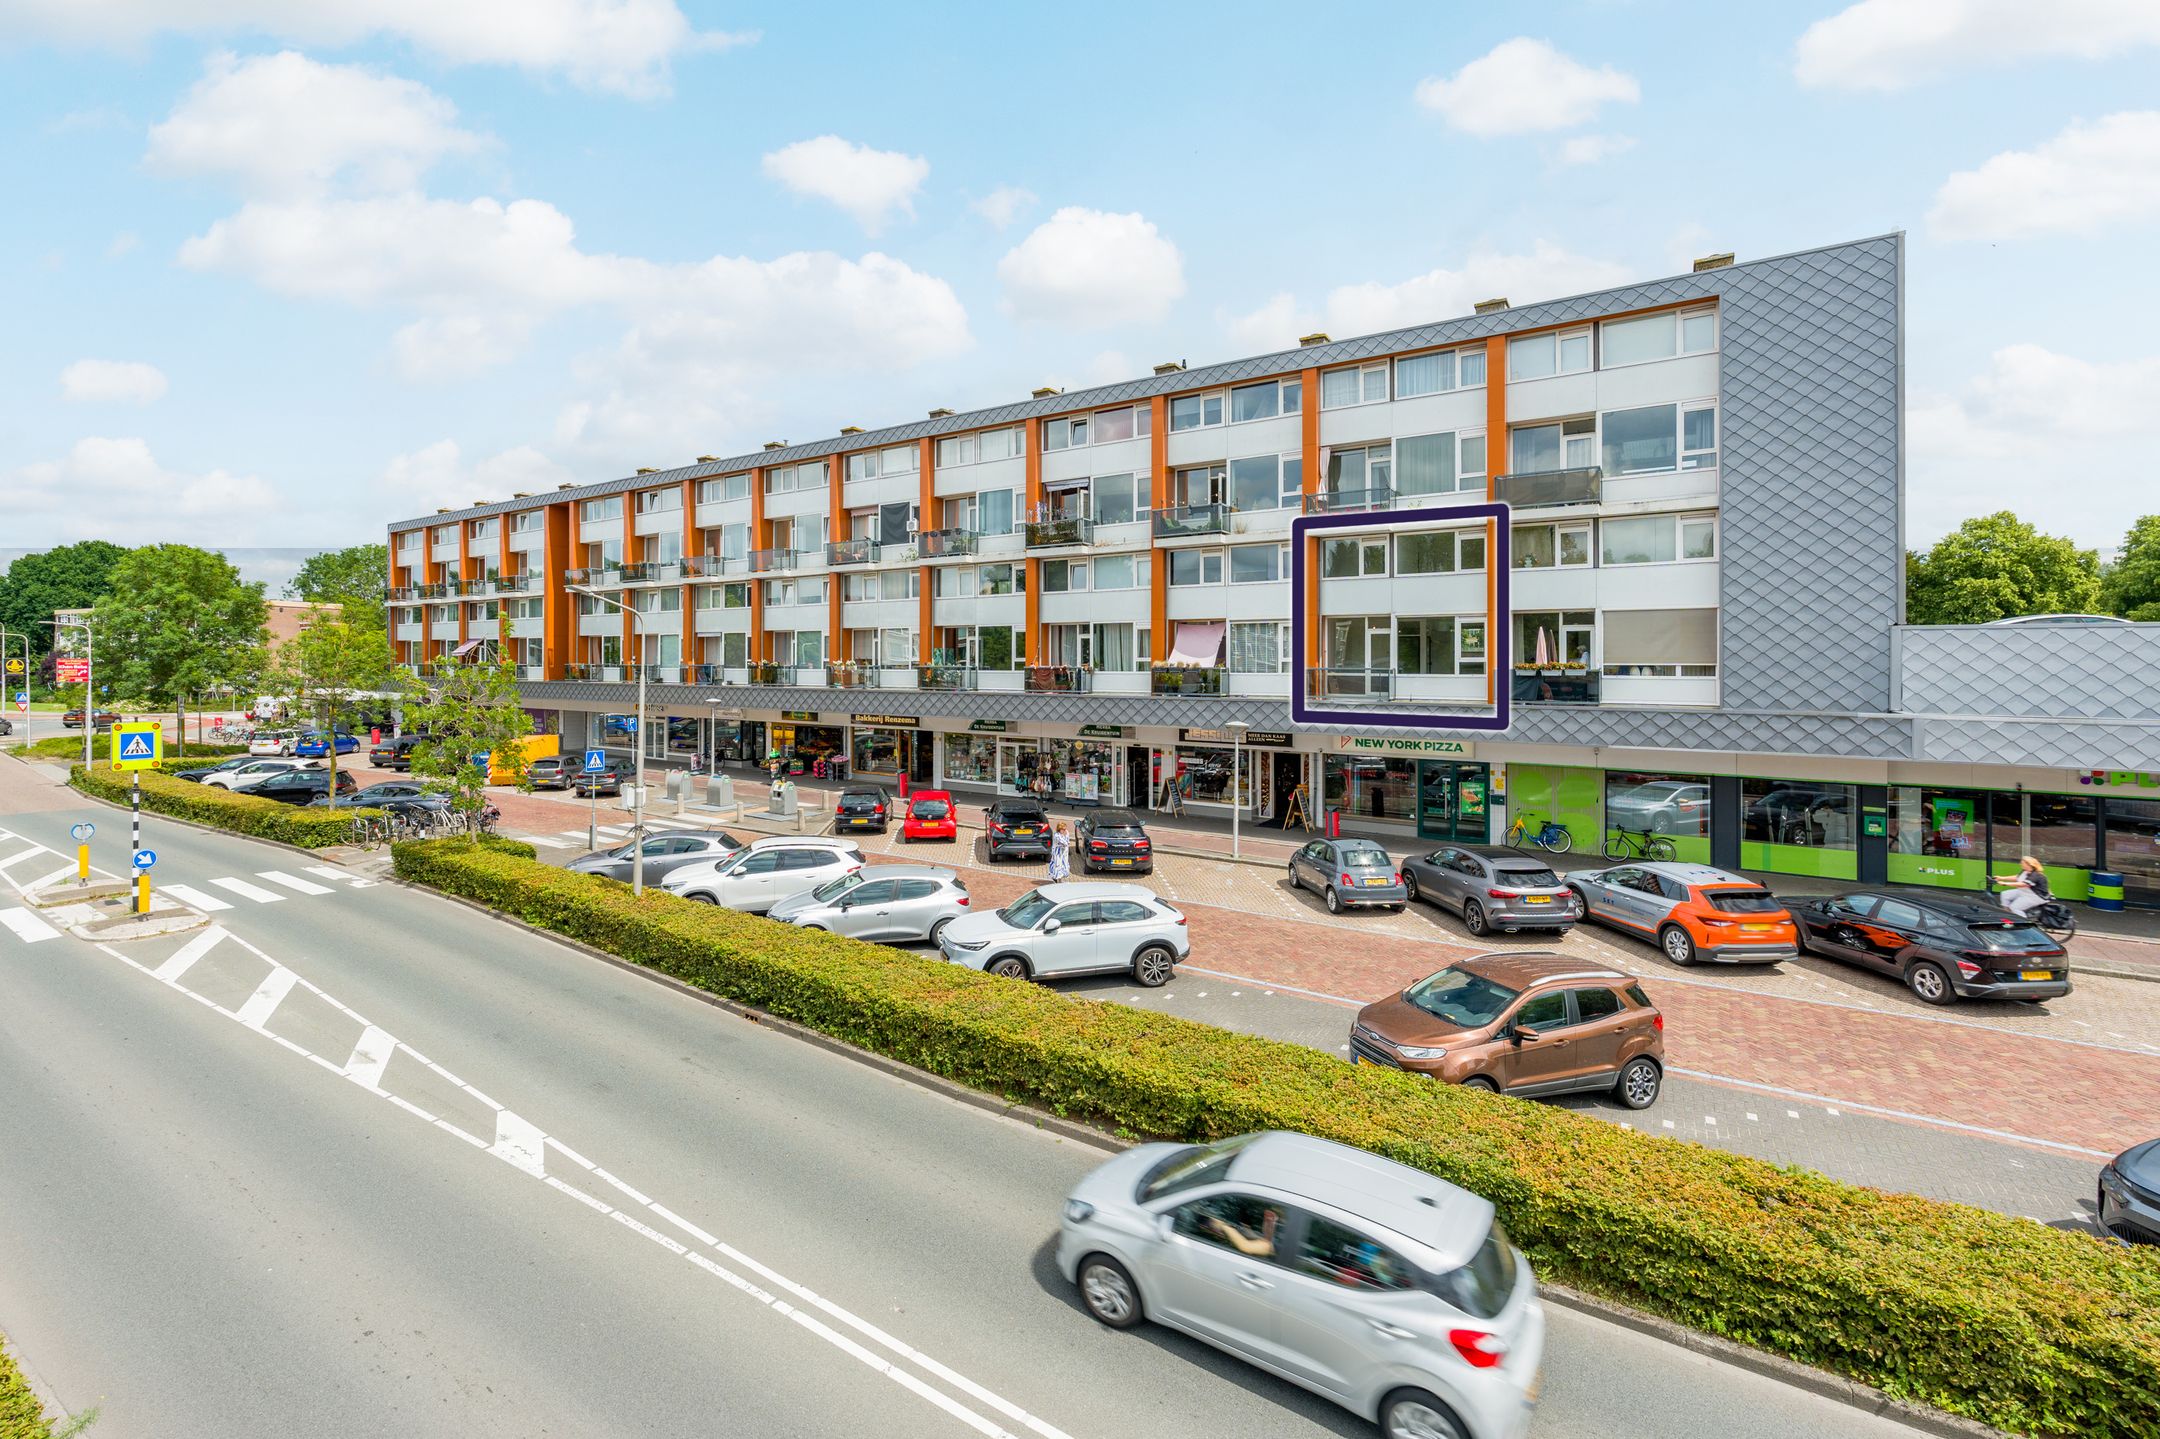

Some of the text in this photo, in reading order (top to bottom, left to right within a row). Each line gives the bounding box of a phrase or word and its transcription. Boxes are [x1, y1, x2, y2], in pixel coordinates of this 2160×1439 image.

[855, 714, 916, 724] Bakkerij Renzema
[1354, 738, 1464, 752] NEW YORK PIZZA
[1926, 867, 1955, 876] PLUS
